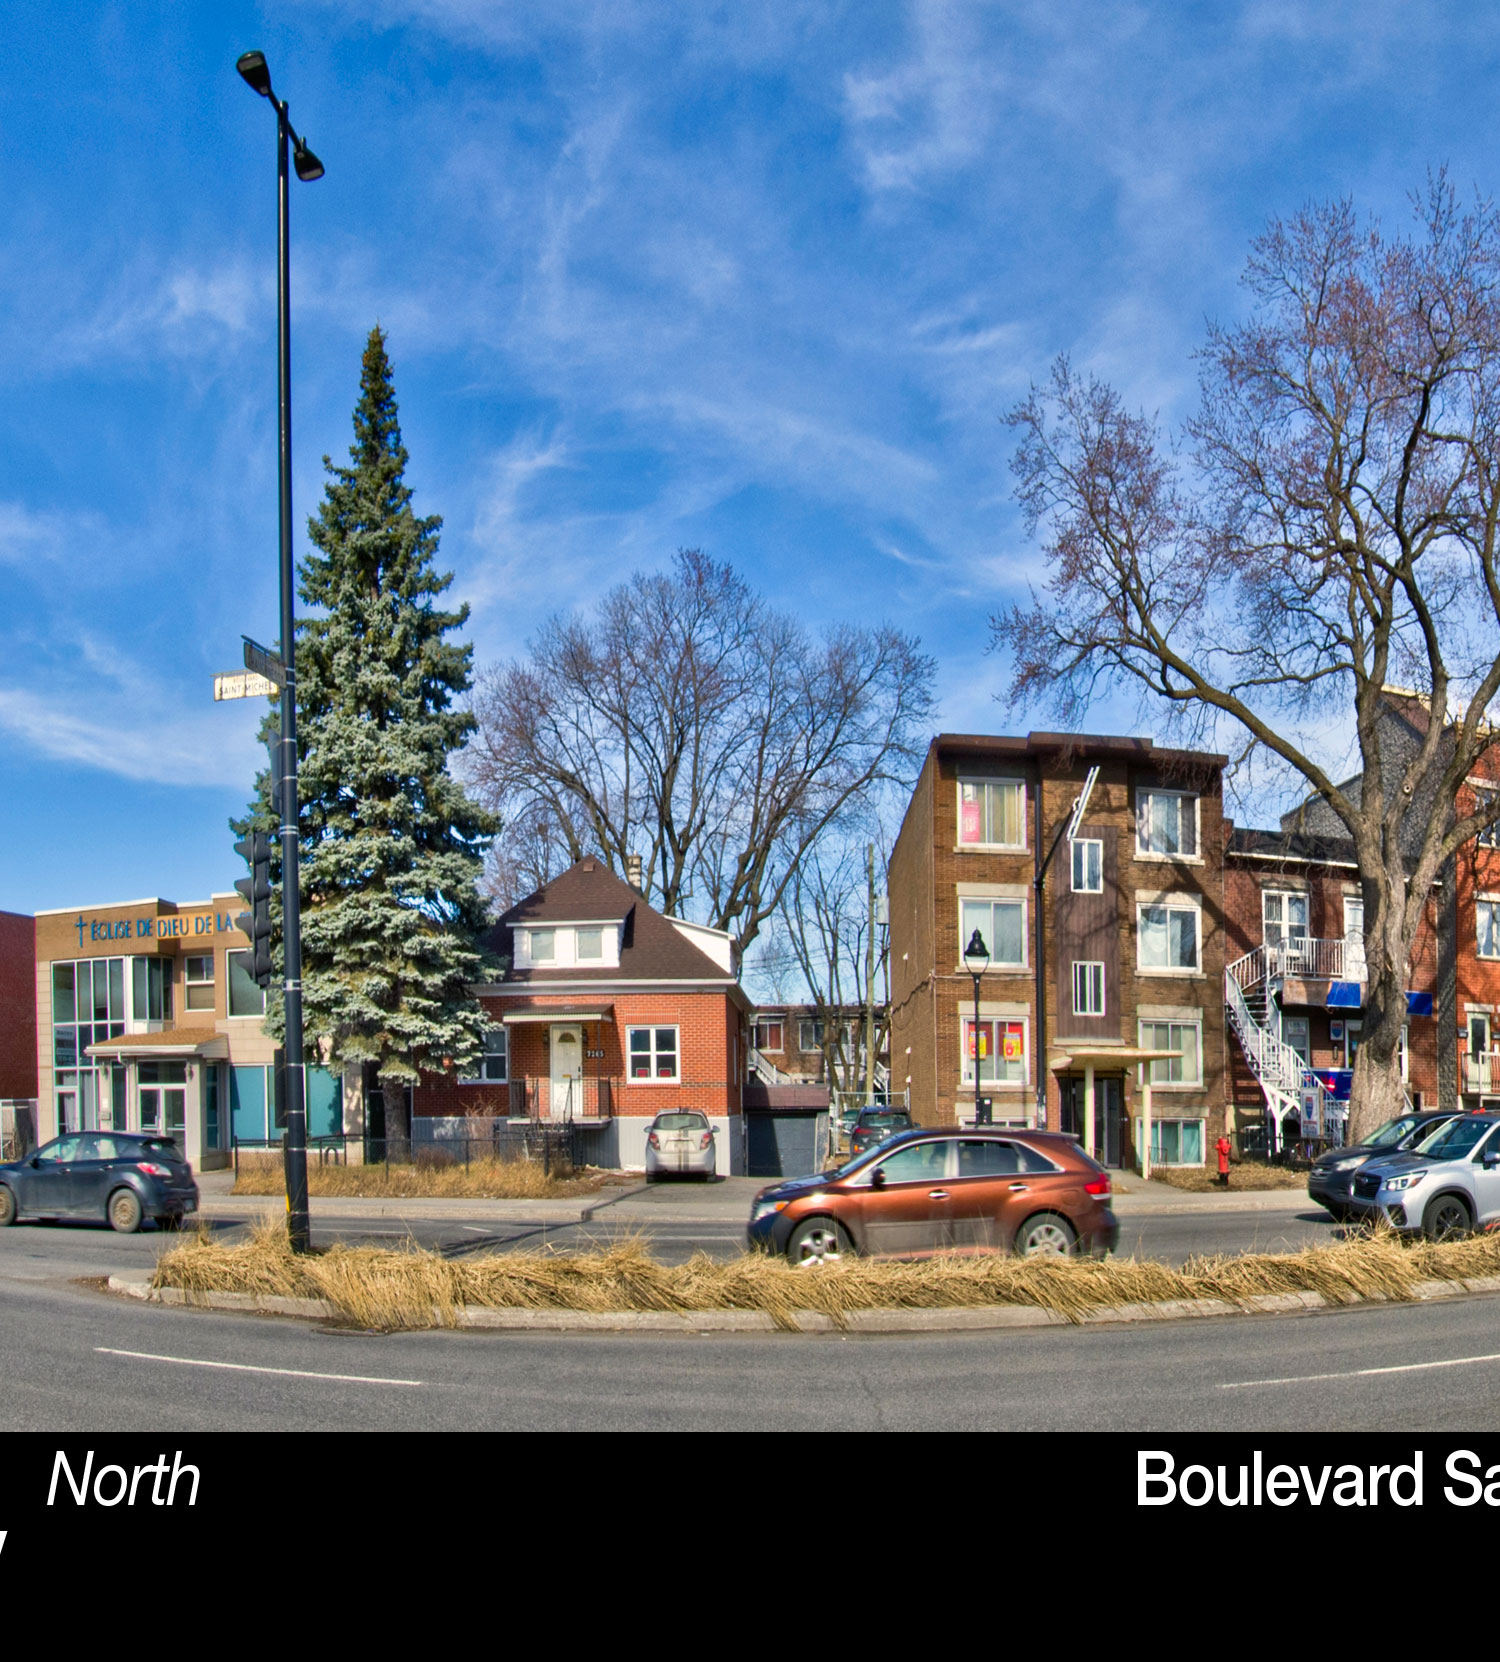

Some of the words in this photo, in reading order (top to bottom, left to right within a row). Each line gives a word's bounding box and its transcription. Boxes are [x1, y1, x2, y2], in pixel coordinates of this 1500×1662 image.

[91, 919, 132, 942] ÉGLISE
[137, 918, 153, 937] DE
[157, 917, 189, 938] DIEU
[194, 915, 213, 935] DE
[217, 911, 234, 932] LA
